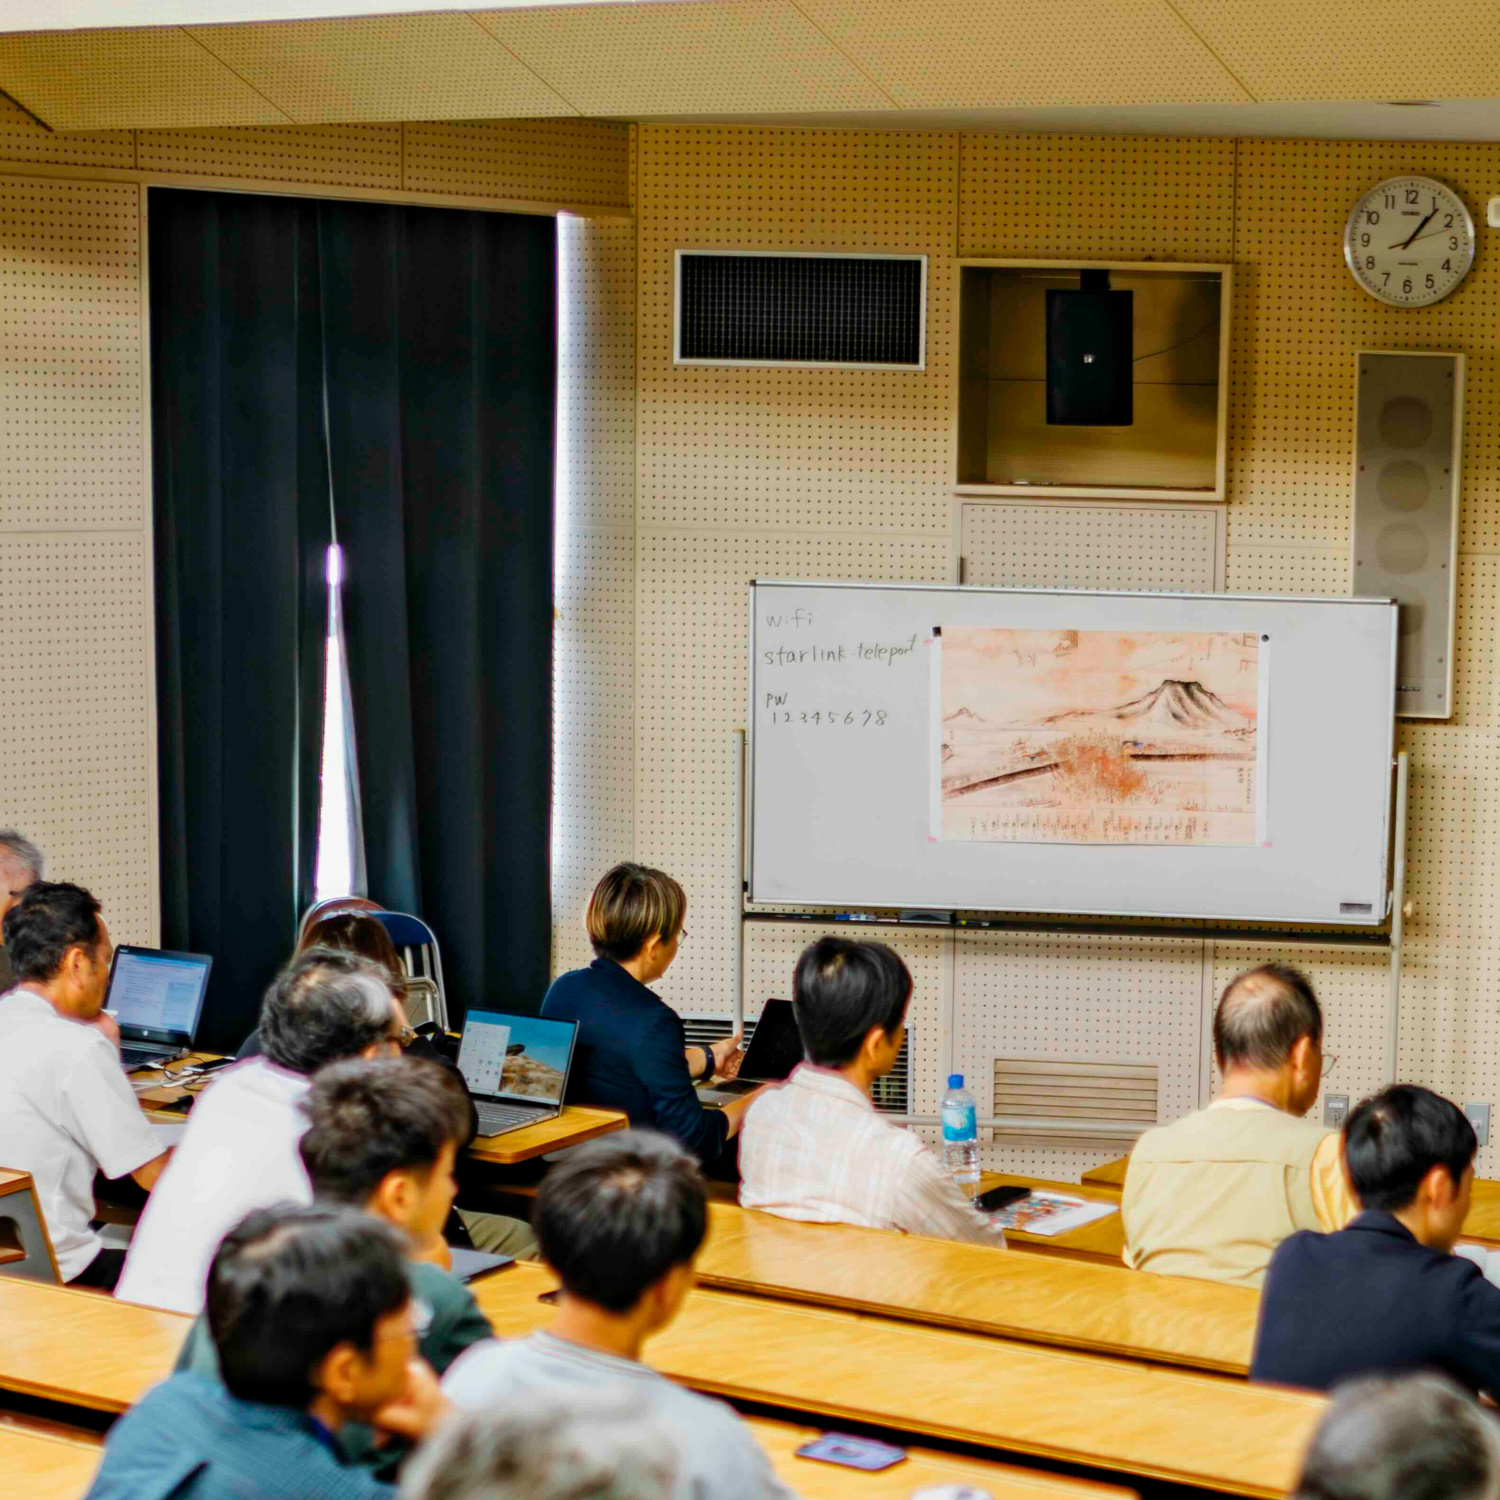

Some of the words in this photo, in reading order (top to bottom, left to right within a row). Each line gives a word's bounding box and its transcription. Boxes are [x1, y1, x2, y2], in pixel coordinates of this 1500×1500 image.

[1384, 195, 1395, 209] 11
[1405, 189, 1419, 204] 12
[1431, 196, 1437, 210] 1
[1366, 210, 1380, 225] 10
[1444, 213, 1453, 228] 2
[1361, 233, 1371, 247] 9
[1449, 236, 1458, 251] 3
[1366, 256, 1375, 270] 8
[1441, 258, 1451, 273] 4
[1381, 272, 1391, 286] 7
[1402, 279, 1412, 294] 6
[1425, 274, 1435, 289] 5
